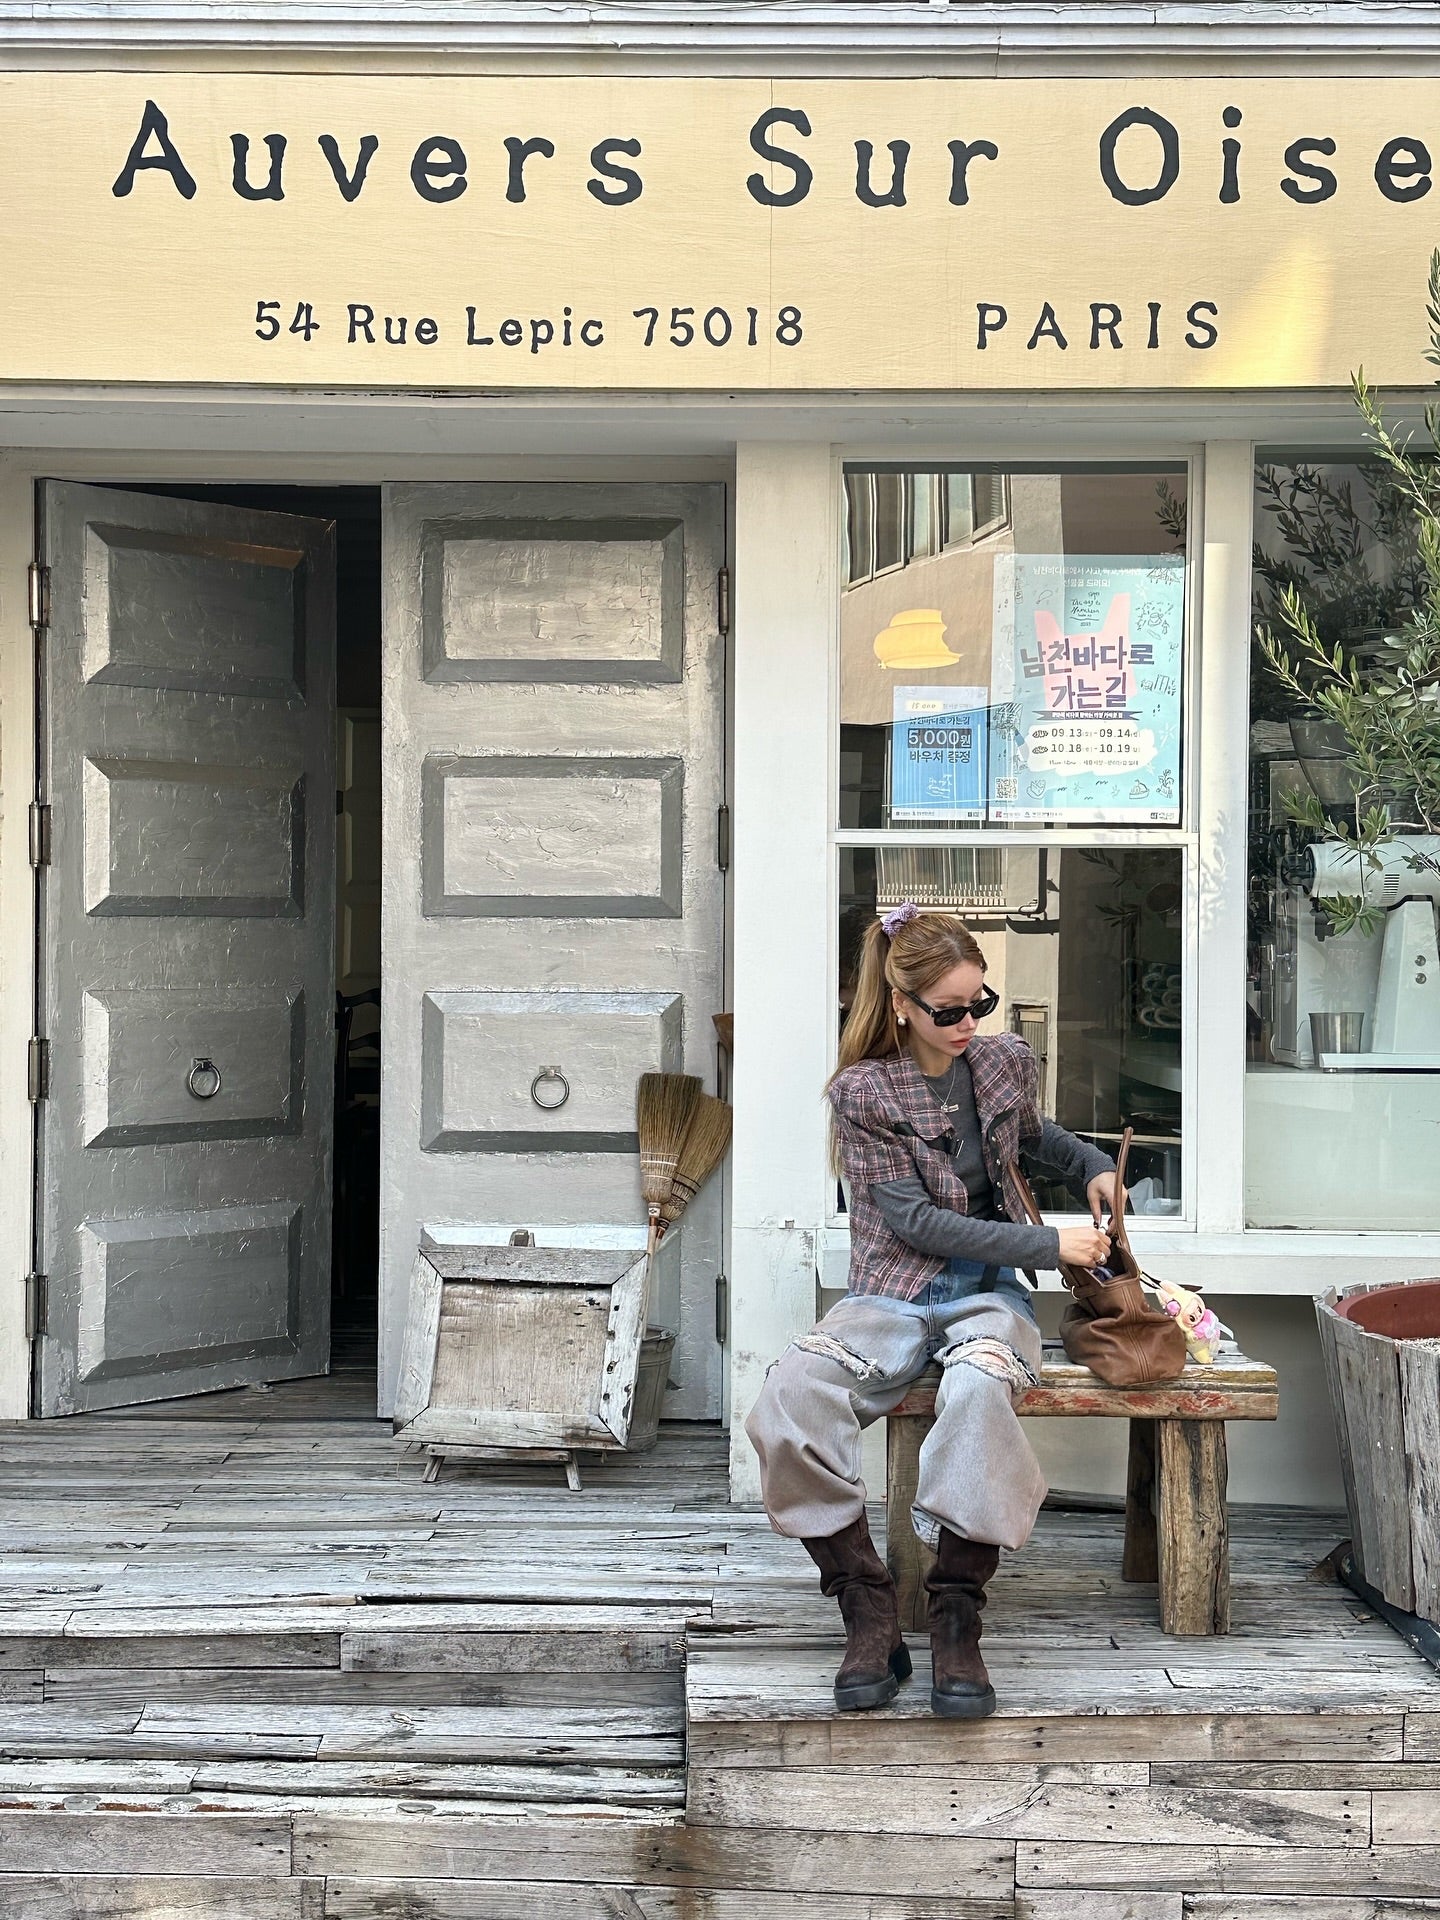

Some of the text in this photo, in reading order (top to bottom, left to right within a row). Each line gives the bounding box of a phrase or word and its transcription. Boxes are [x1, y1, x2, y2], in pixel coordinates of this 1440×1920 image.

[112, 100, 1433, 208] Auvers Sur Oise
[256, 301, 1217, 354] 54 Rue Lepic 75018 PARIS
[1020, 636, 1154, 678] 남천바다로
[908, 729, 971, 748] 5,000원
[909, 750, 943, 764] 바우처
